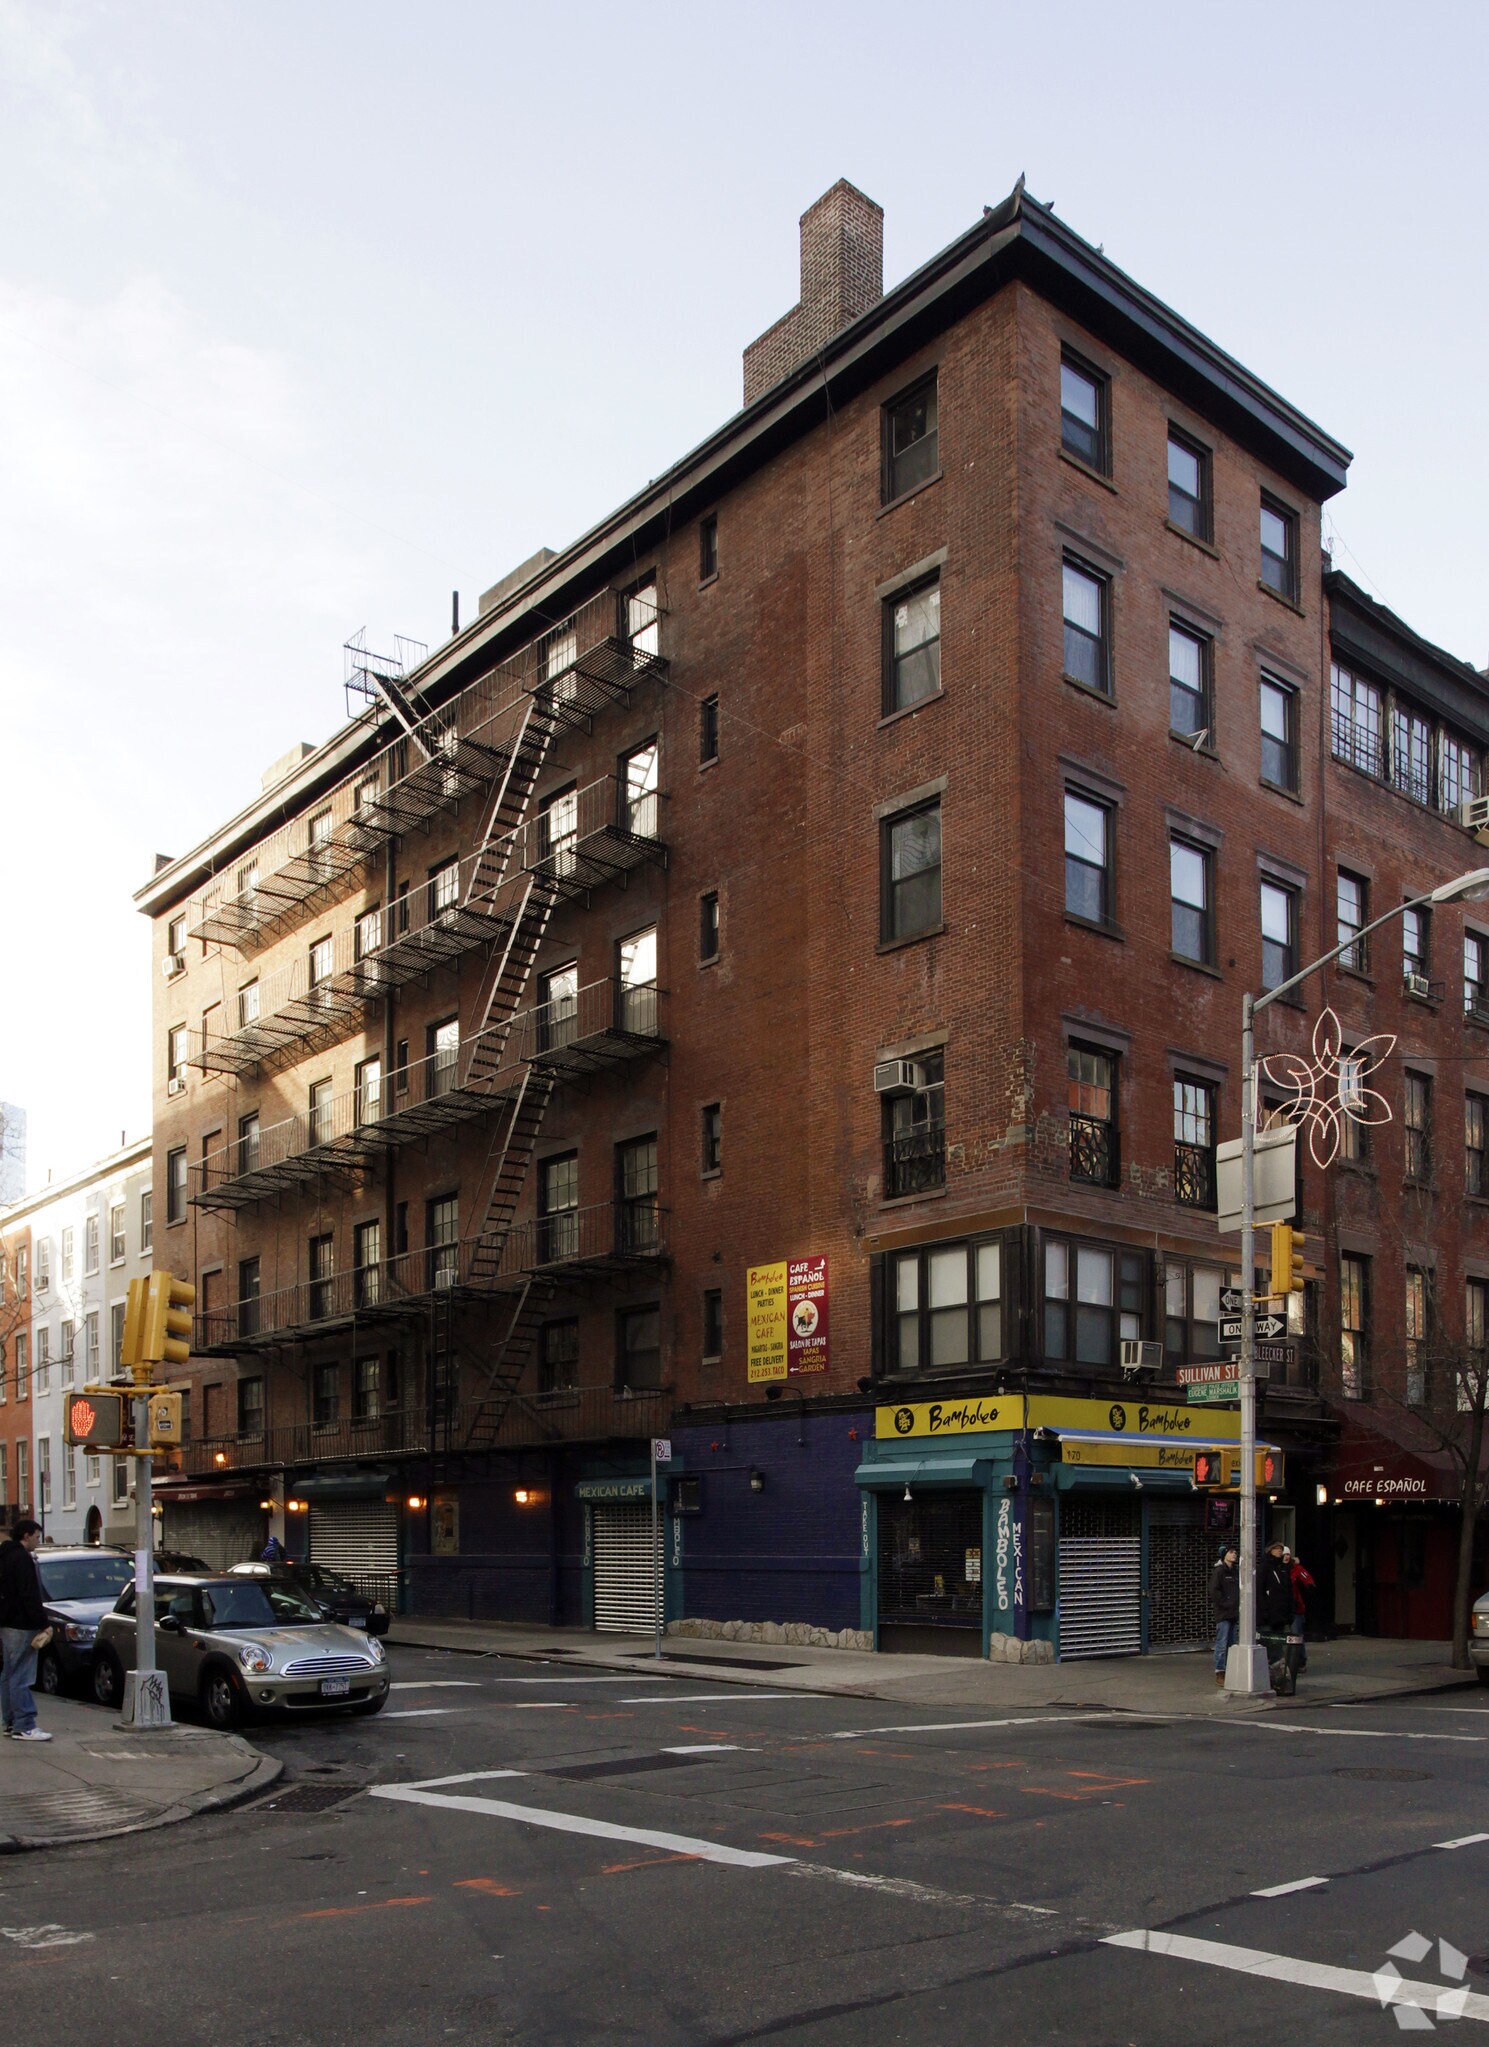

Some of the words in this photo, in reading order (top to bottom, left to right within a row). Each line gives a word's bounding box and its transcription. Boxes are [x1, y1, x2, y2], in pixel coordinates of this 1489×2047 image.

[790, 1262, 809, 1274] CAFE
[789, 1271, 825, 1286] ESPAÑOL
[750, 1289, 764, 1299] LUNCH
[768, 1286, 784, 1296] DINNER
[789, 1285, 808, 1294] SPANISH
[808, 1281, 826, 1291] CUISINE
[789, 1293, 806, 1302] LUNCH
[807, 1289, 825, 1299] DINNER
[1225, 1296, 1238, 1306] ONE
[757, 1299, 775, 1308] PARTIES
[751, 1312, 785, 1326] MEXICAN
[755, 1327, 775, 1339] CAFE
[1256, 1321, 1277, 1333] WAY
[805, 1338, 812, 1348] DE
[811, 1336, 827, 1347] TAPAS
[803, 1347, 819, 1356] TAPAS
[1254, 1345, 1284, 1362] BLEECKER
[1286, 1348, 1294, 1363] ST
[751, 1358, 762, 1367] FREE
[762, 1354, 784, 1366] DELIVERY
[799, 1356, 826, 1365] SANGRIA
[800, 1364, 825, 1373] GARDEN
[1179, 1366, 1221, 1384] SULLIVAN
[1225, 1364, 1236, 1380] ST
[1188, 1389, 1207, 1398] EUGENE
[928, 1401, 1001, 1432] Bamboleo
[1138, 1406, 1191, 1432] Bamboleo
[1066, 1450, 1081, 1461] 170
[1158, 1447, 1193, 1466] Bamboleo
[579, 1486, 618, 1498] MEXICAN
[620, 1484, 645, 1496] CAFE
[1344, 1480, 1373, 1493] CAFE
[1376, 1478, 1427, 1493] ESPAÑOL
[673, 1518, 681, 1566] MBOLEO
[996, 1498, 1011, 1610] BAMBOLEO
[1012, 1522, 1023, 1605] MEXICAN
